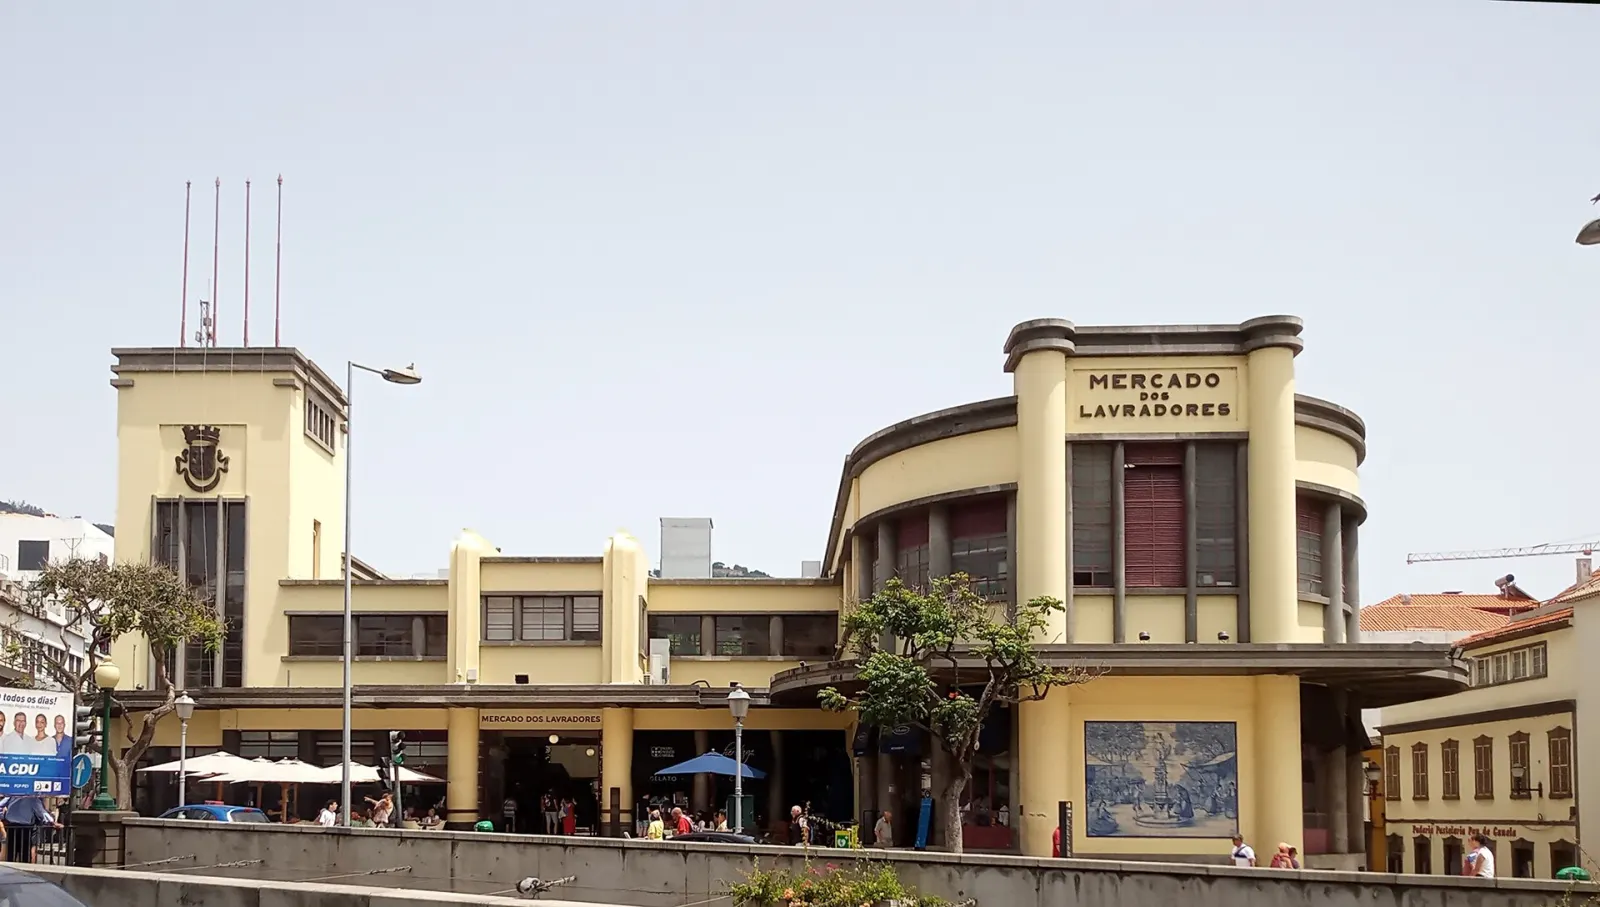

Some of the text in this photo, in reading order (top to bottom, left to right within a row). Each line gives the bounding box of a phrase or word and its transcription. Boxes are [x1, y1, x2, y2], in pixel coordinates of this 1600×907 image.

[1089, 373, 1220, 390] MERCADO
[1139, 391, 1170, 401] DOS
[1079, 403, 1231, 418] LAVRADORES
[3, 693, 25, 703] todos
[27, 696, 36, 704] os
[37, 696, 58, 706] dias!
[481, 715, 601, 723] MERCADO DOS LAVRADORES
[8, 763, 39, 776] CDU
[1436, 825, 1466, 835] Pastelaria
